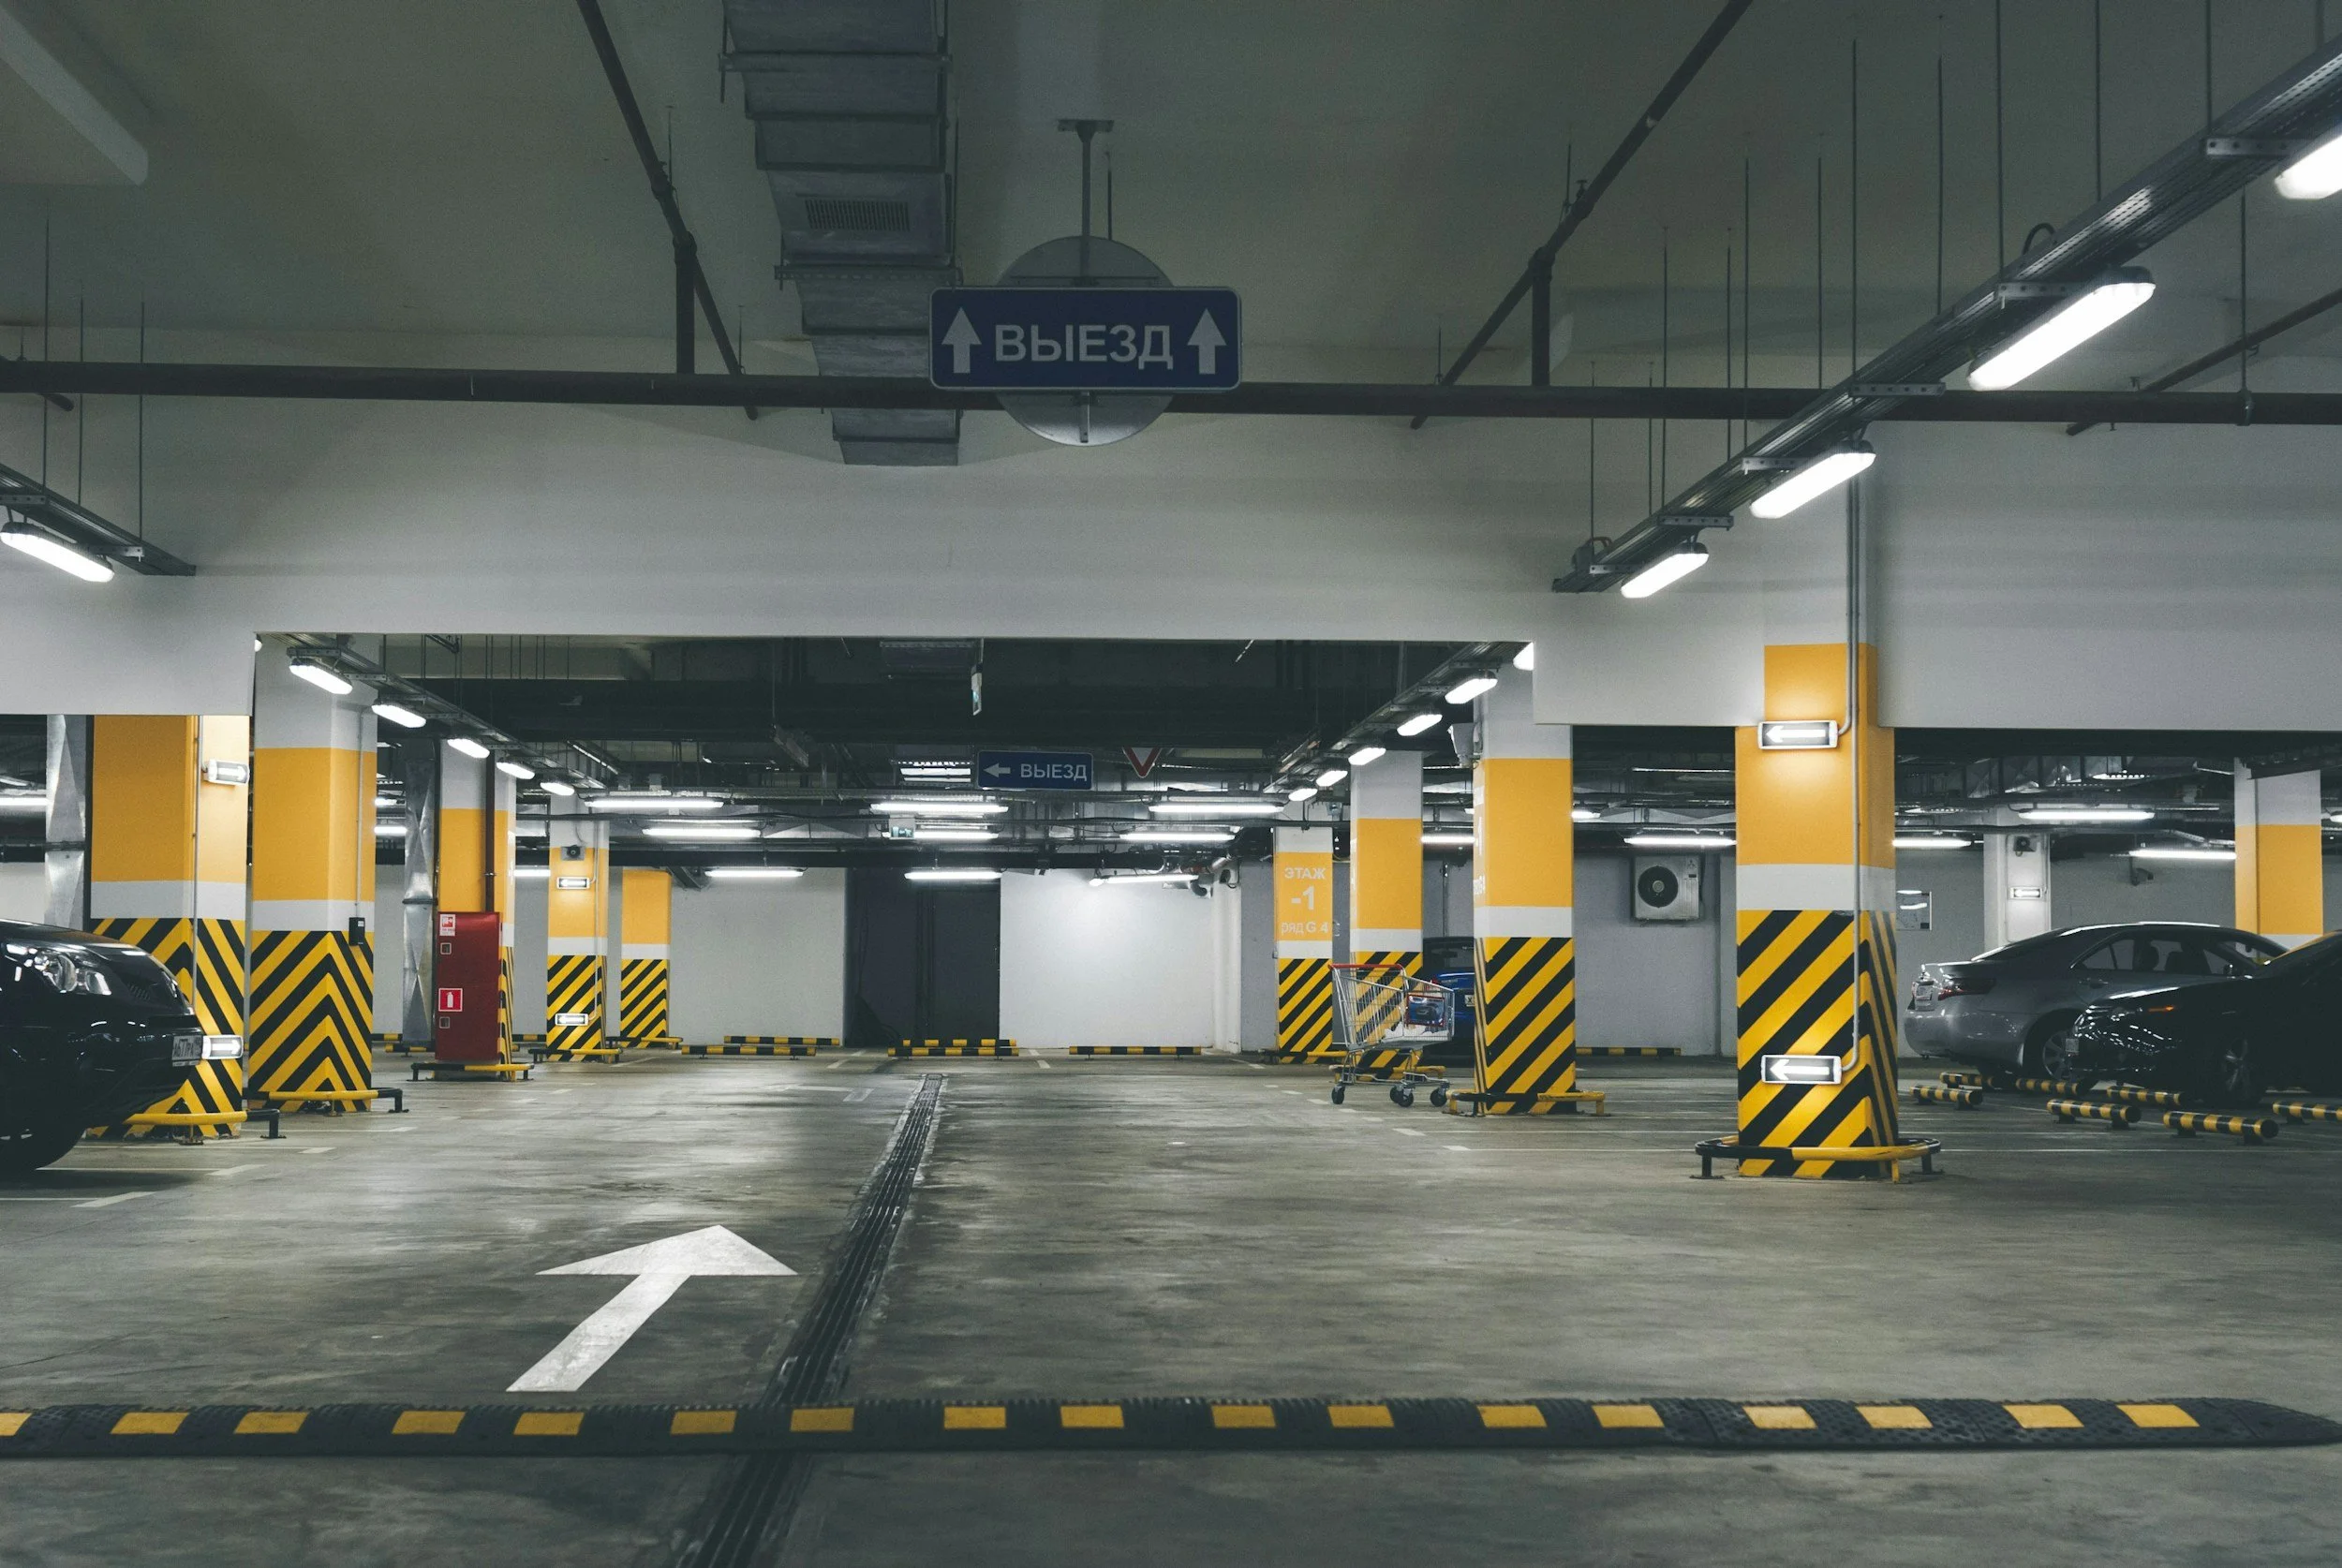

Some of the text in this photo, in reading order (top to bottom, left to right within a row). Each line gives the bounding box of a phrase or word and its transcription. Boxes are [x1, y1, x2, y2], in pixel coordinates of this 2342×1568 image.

[995, 324, 1173, 370] ВЫЕЗД
[1020, 763, 1087, 781] ВЫЕЗД
[1284, 866, 1326, 879] ЭТАЖ
[1291, 885, 1314, 910] -1
[1320, 922, 1328, 933] 4
